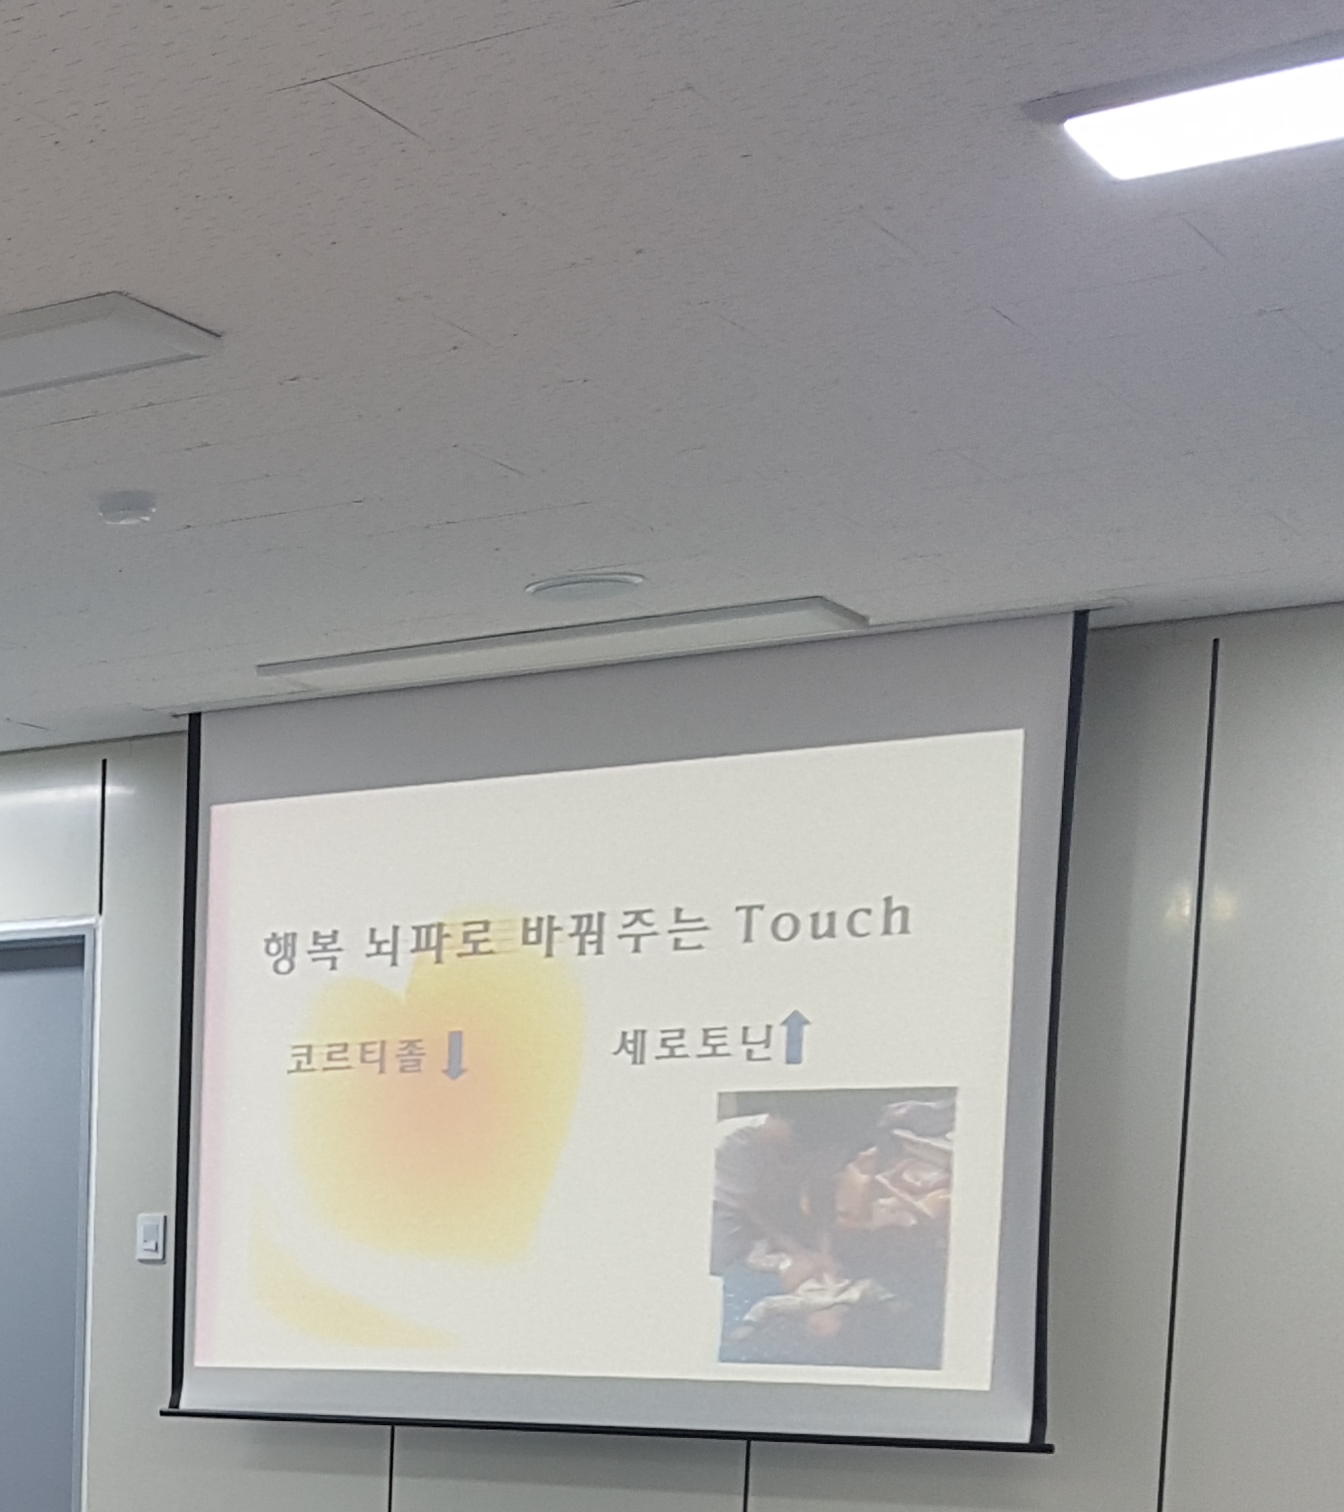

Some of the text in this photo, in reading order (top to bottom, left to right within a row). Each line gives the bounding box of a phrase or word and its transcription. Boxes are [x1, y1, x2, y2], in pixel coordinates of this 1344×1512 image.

[263, 894, 912, 976] 행복 뇌파로 바꿔주는 Touch
[286, 1038, 427, 1075] 코르티졸
[612, 1023, 774, 1066] 세로토닌
